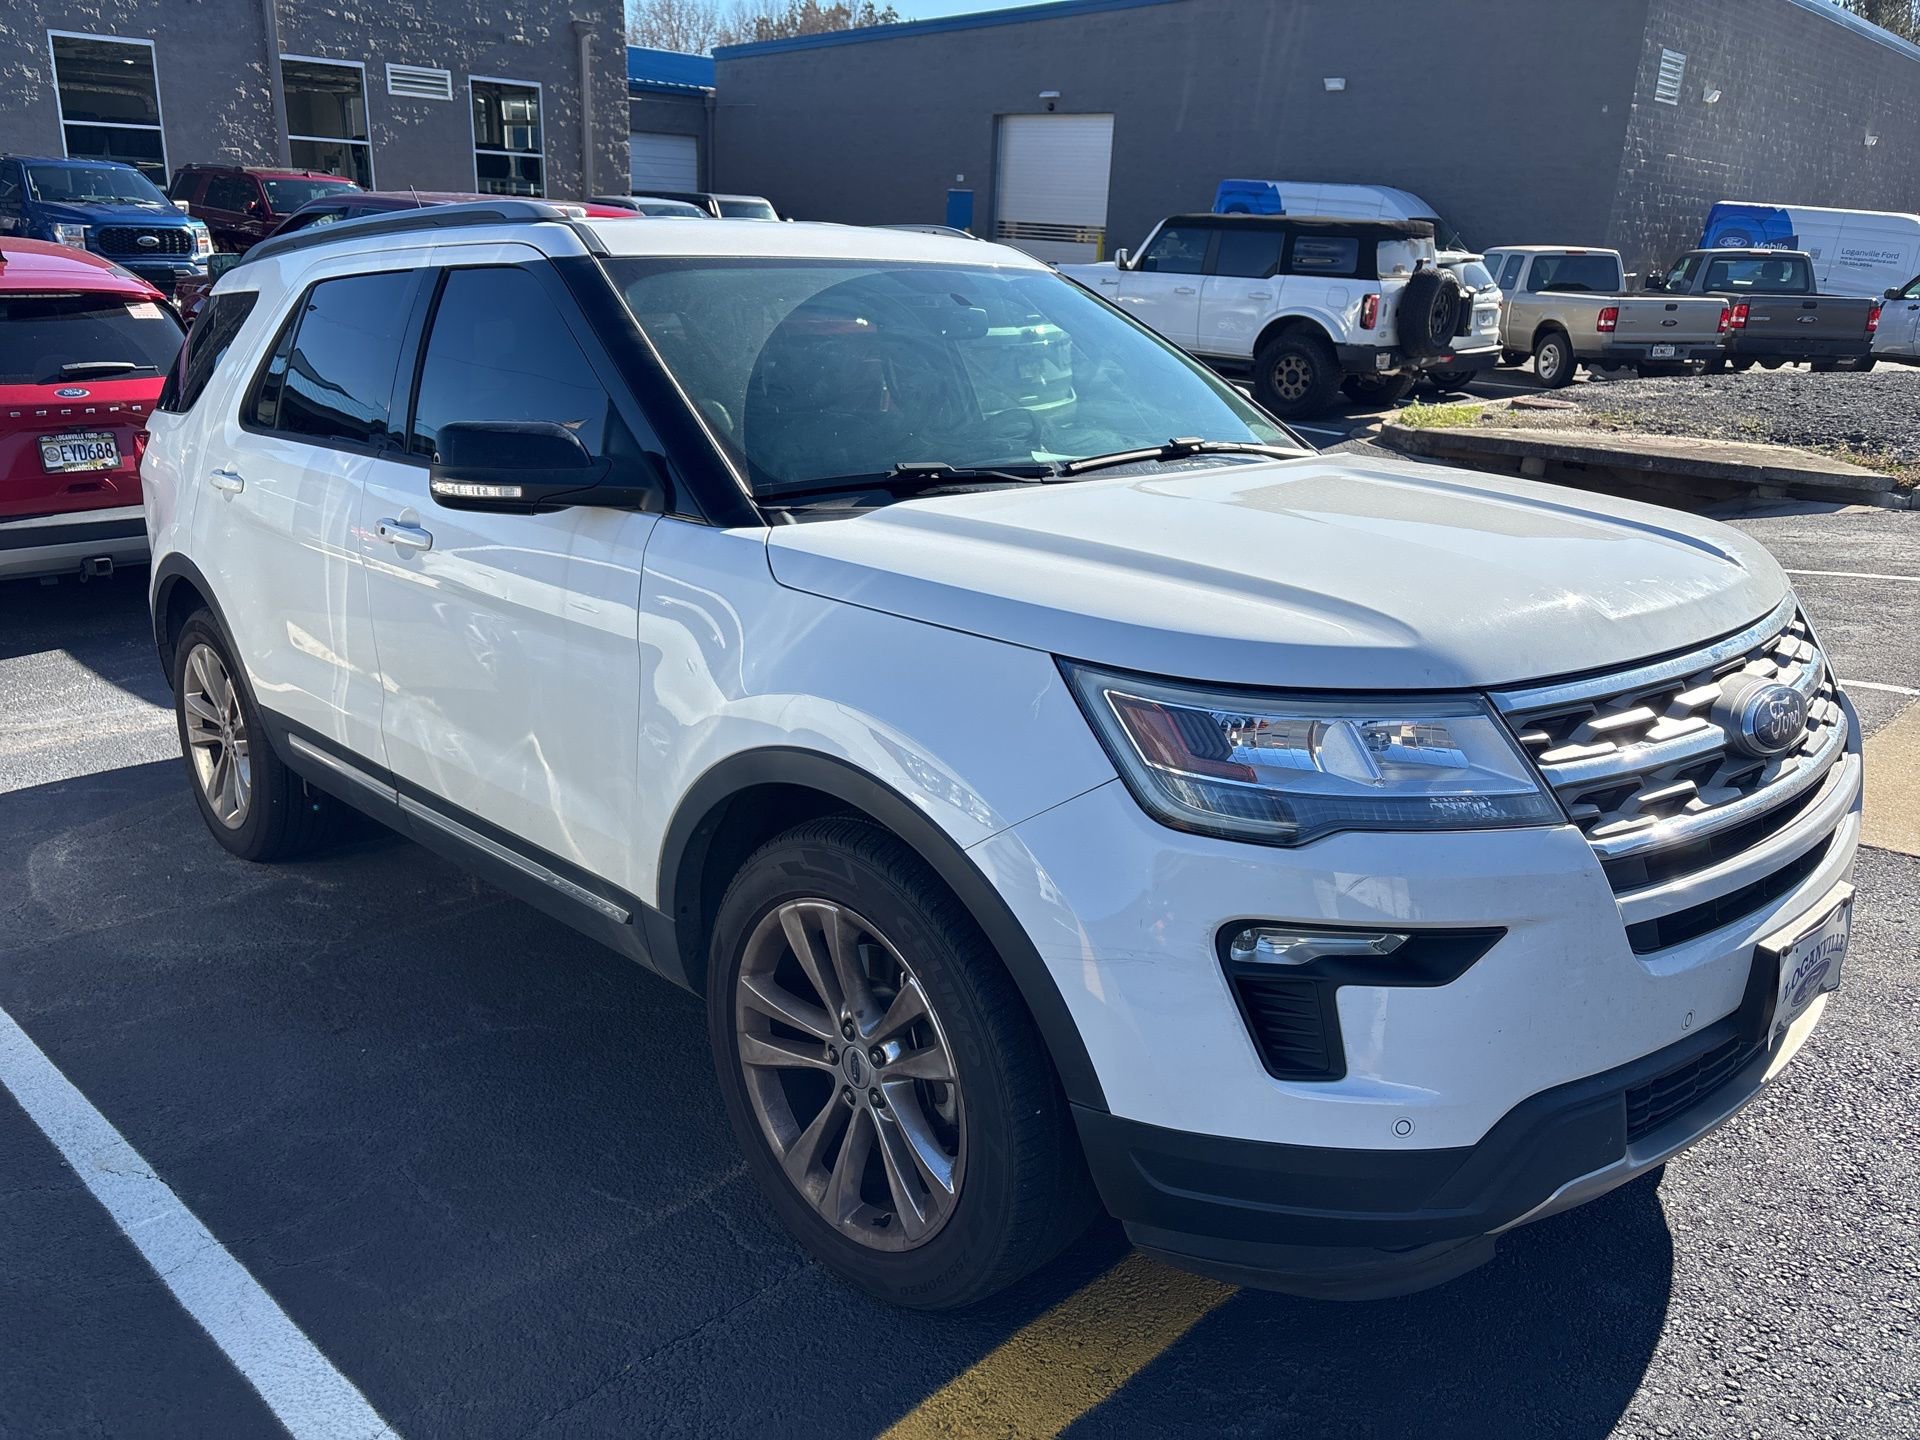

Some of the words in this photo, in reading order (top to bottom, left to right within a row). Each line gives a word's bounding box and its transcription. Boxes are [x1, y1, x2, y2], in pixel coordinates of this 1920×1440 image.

[1753, 241, 1789, 250] Mobile
[1841, 248, 1881, 259] Loganville
[1881, 251, 1900, 260] Ford
[55, 433, 84, 442] LOGANVILLE
[84, 432, 98, 440] FORD
[60, 442, 114, 462] EYD688
[1770, 696, 1802, 740] Ford
[1782, 933, 1845, 1004] LOGANVILLE
